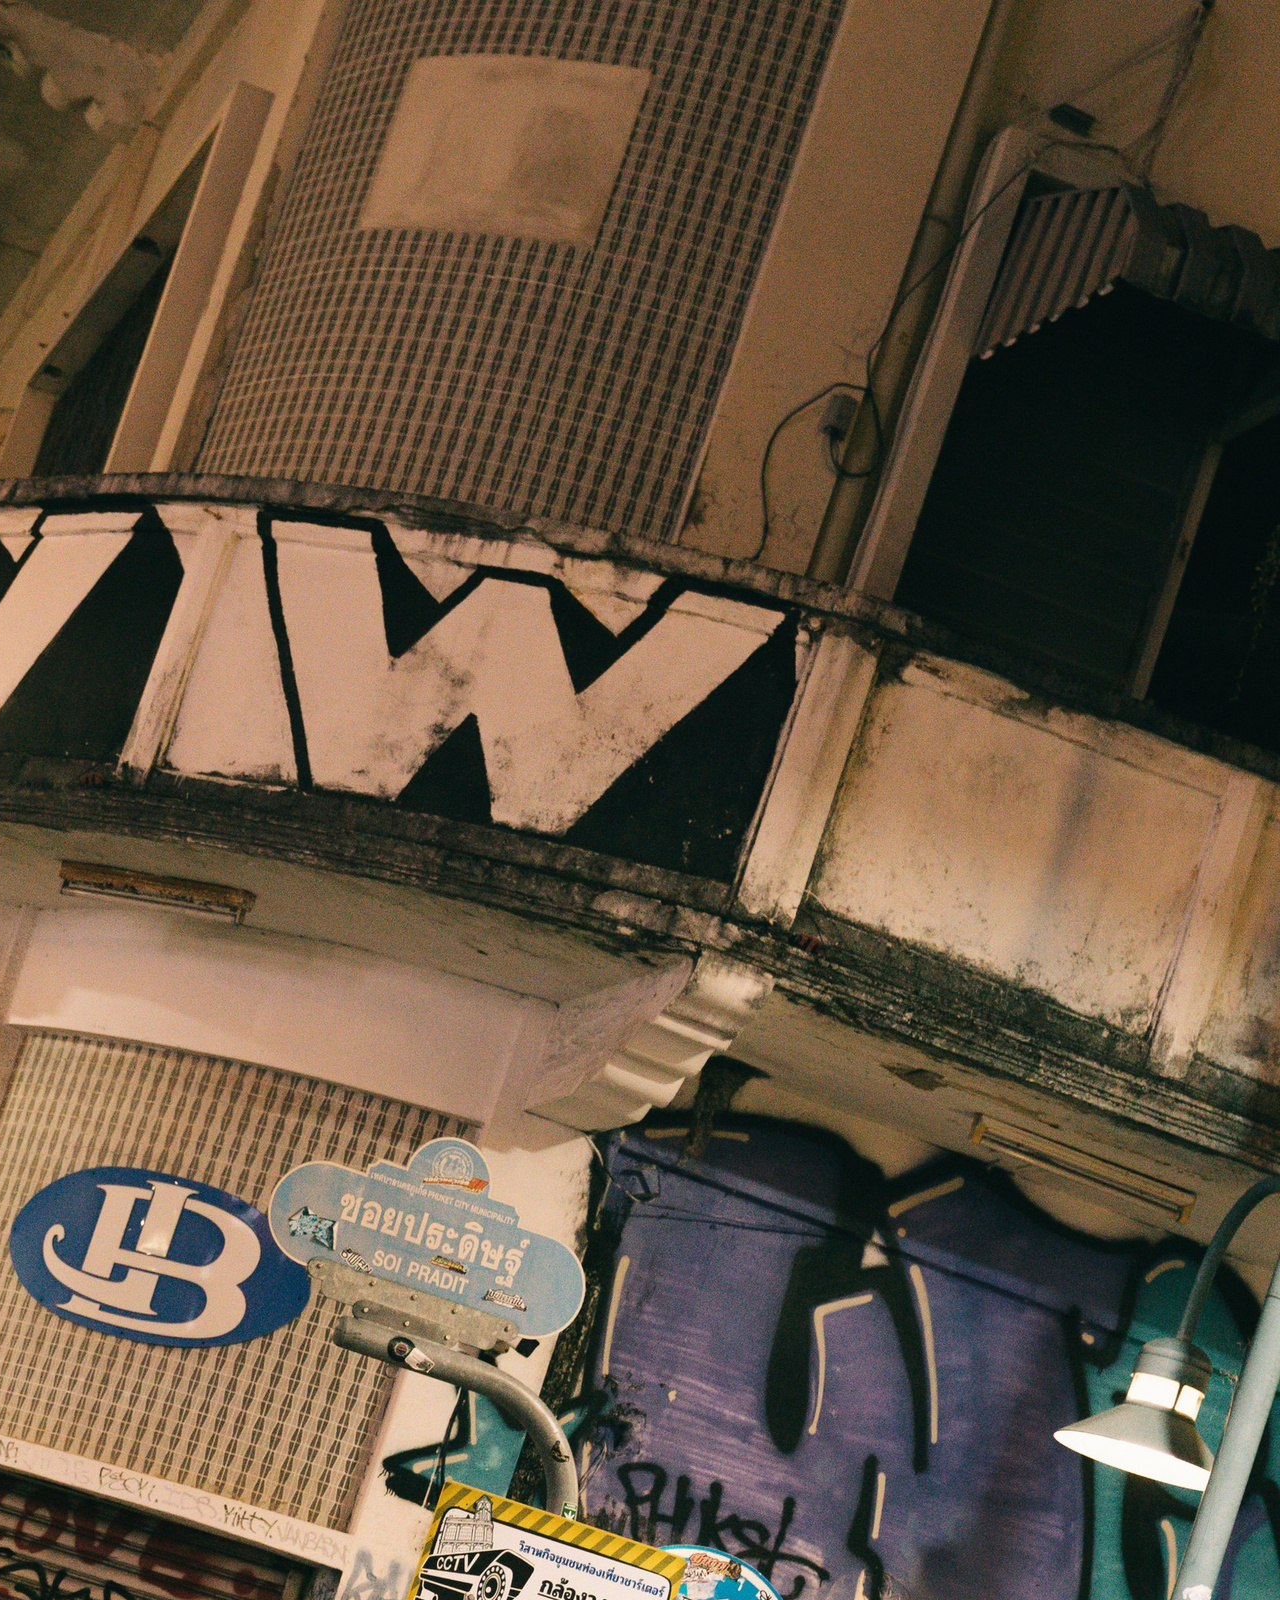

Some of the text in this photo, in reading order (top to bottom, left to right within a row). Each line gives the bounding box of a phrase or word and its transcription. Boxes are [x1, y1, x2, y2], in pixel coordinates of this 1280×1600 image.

[427, 1189, 454, 1206] PHUKET
[454, 1199, 471, 1212] CITY
[471, 1203, 516, 1226] MUNICIPALITY
[372, 1249, 402, 1274] SOI
[406, 1261, 470, 1295] PRADIT
[436, 1553, 481, 1573] CCTV
